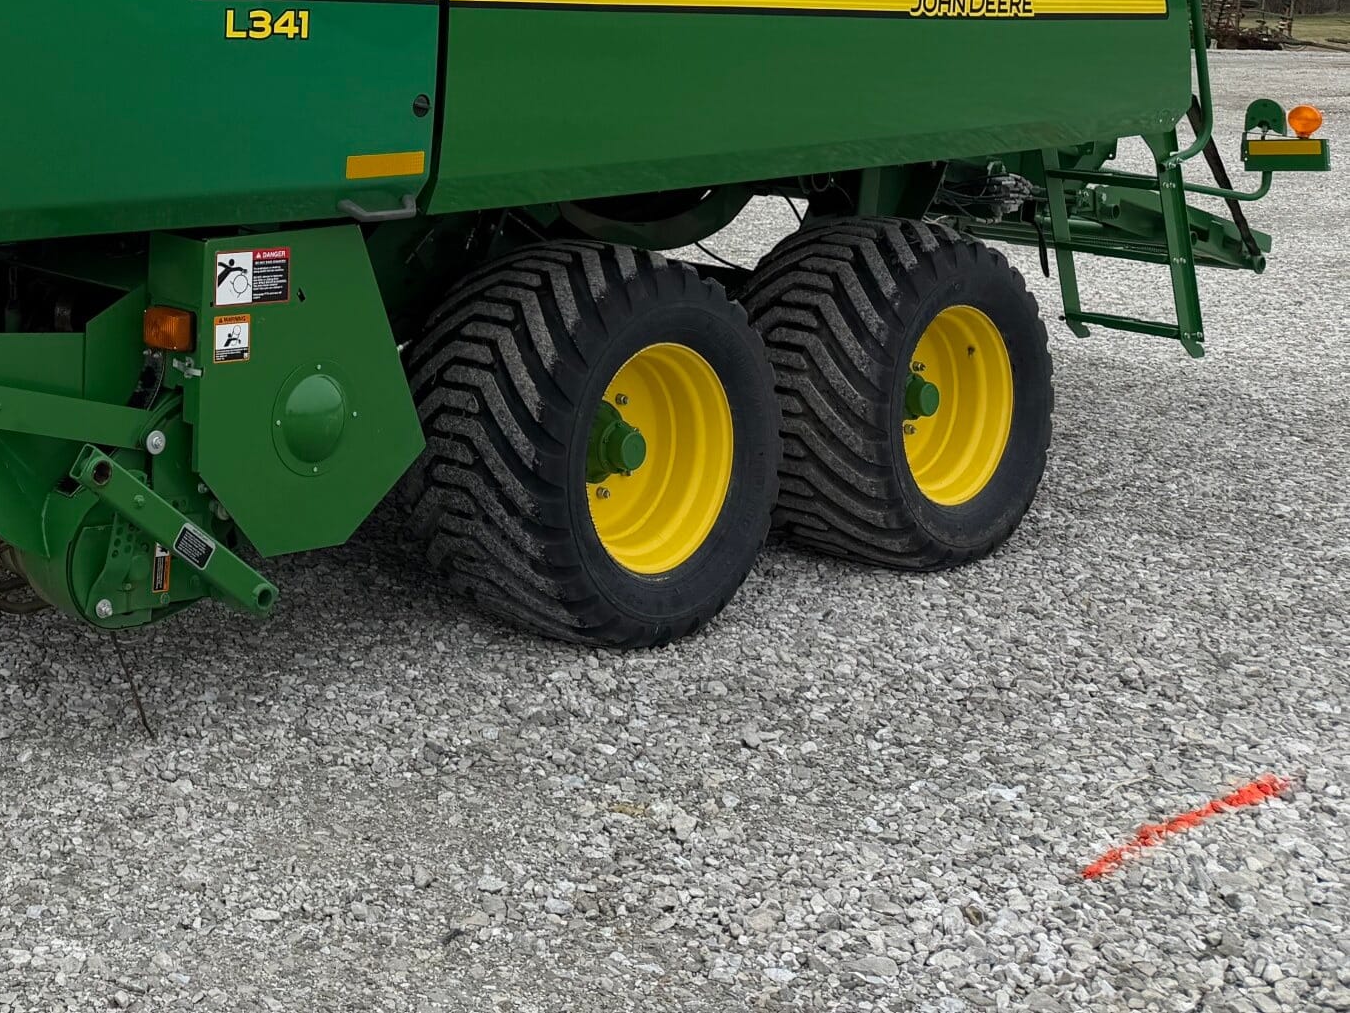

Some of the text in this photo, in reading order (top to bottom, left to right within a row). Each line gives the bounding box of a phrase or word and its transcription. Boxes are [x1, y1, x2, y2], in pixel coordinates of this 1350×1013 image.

[225, 8, 310, 40] L341
[262, 250, 286, 259] DANGER
[223, 315, 247, 323] WARNING
